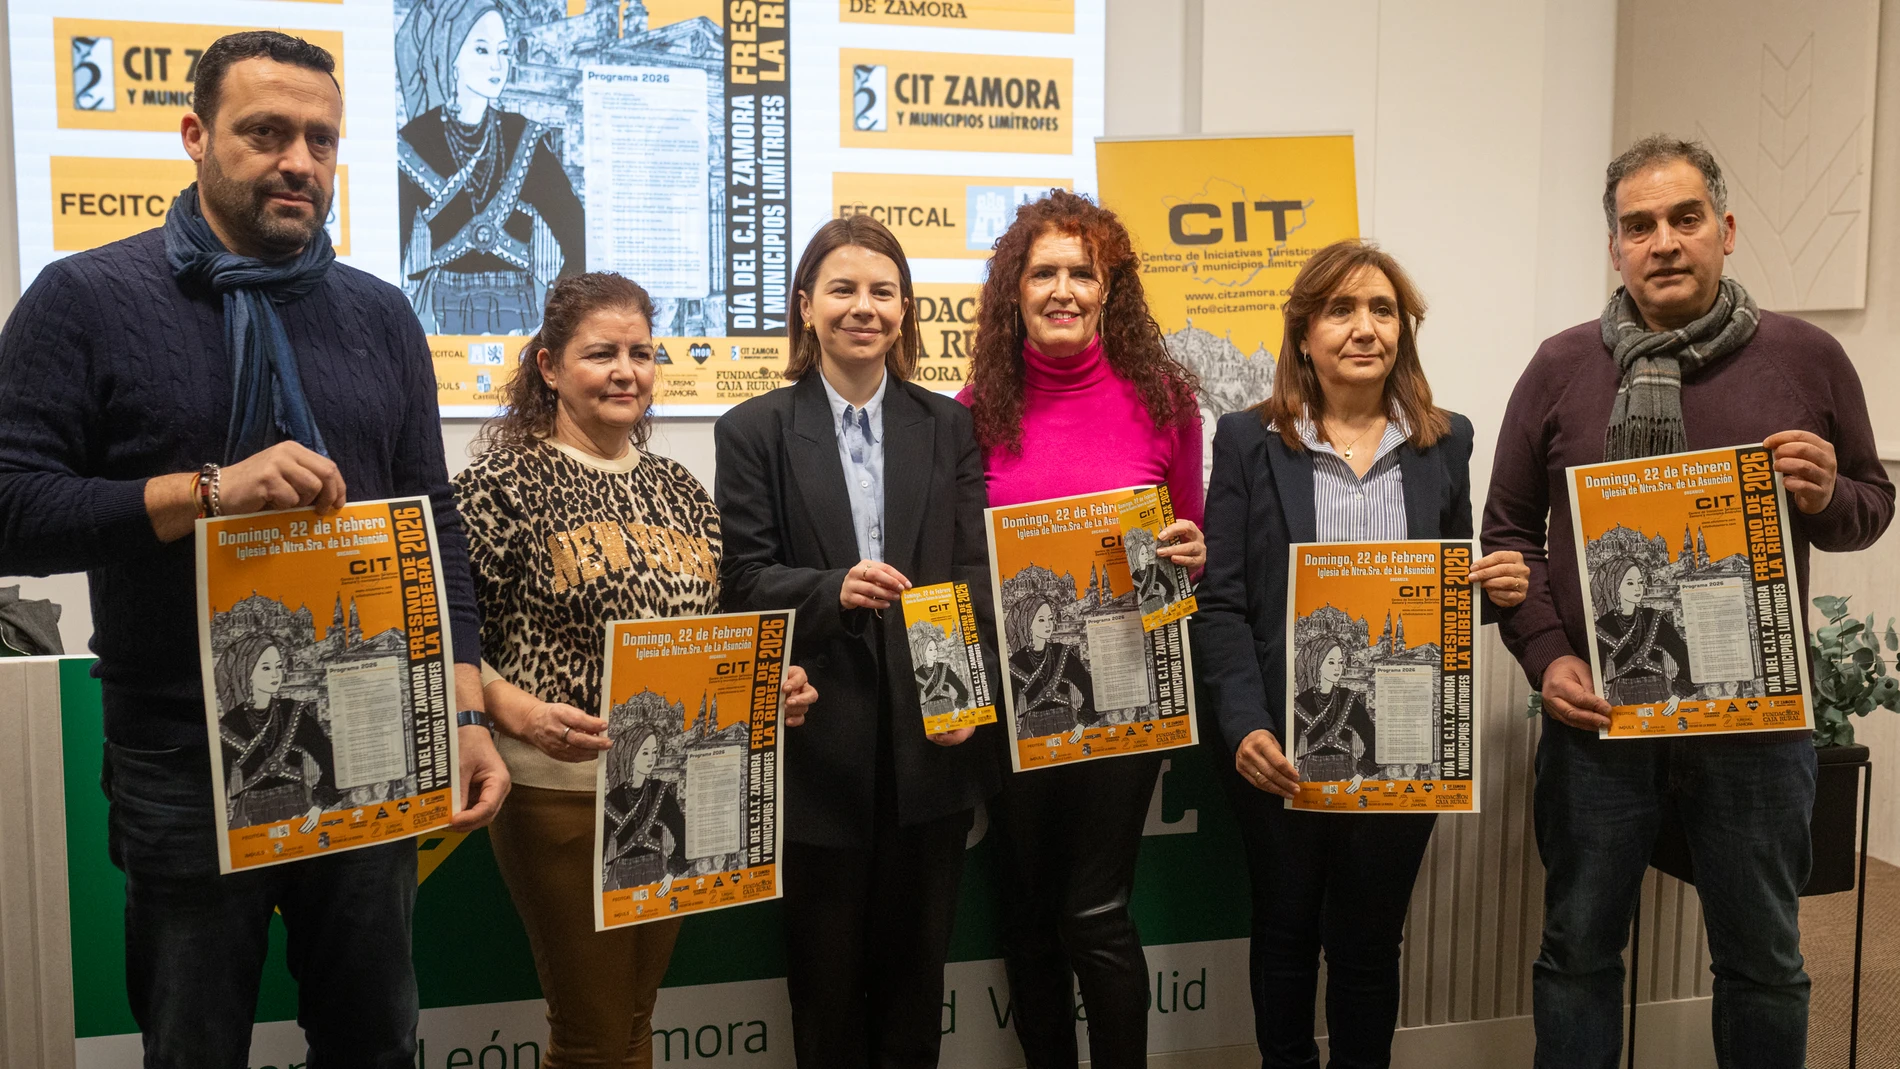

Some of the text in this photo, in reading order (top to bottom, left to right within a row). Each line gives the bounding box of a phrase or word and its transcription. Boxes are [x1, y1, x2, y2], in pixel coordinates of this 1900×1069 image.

[849, 0, 968, 19] DE ZAMORA
[730, 0, 757, 85] FRES
[759, 40, 785, 82] LA
[123, 47, 172, 82] CIT
[588, 71, 670, 83] Programa 2026
[894, 73, 1061, 110] CIT ZAMORA
[897, 111, 1059, 131] Y MUNICIPIOS LIMÍTROFES
[61, 193, 178, 217] FECITC
[728, 95, 757, 330] DÍA DEL C.I.T. ZAMORA
[757, 95, 786, 331] Y MUNICIPIOS LIMÍTROFES
[1169, 201, 1303, 246] CIT
[1142, 252, 1182, 263] Centro
[1186, 251, 1200, 261] de
[1204, 249, 1263, 260] Iniciativas
[1143, 264, 1188, 274] Zamora
[1192, 265, 1198, 275] y
[1203, 261, 1264, 272] municipios
[741, 347, 779, 355] CIT ZAMORA
[717, 381, 745, 391] CAJA
[1585, 461, 1732, 489] Domingo, 22 de Febrero
[1602, 487, 1627, 500] Iglesia
[1628, 484, 1638, 495] de
[1677, 479, 1686, 490] de
[1688, 478, 1697, 488] La
[1698, 474, 1733, 486] Asunción
[1740, 451, 1773, 492] 2026
[1002, 514, 1053, 529] Domingo,
[1056, 508, 1070, 521] 22
[1074, 506, 1087, 519] de
[1090, 502, 1117, 516] Febr
[1140, 508, 1157, 519] CIT
[1696, 495, 1735, 510] CIT
[218, 517, 387, 546] Domingo, 22 de Febrero
[394, 507, 427, 554] 2026
[1017, 528, 1040, 540] Iglesia
[1042, 526, 1050, 535] de
[1085, 520, 1093, 529] de
[1094, 518, 1102, 528] La
[1101, 535, 1122, 549] CI
[1745, 494, 1770, 582] FRESNO DE
[1761, 494, 1785, 579] LA RIBERA
[350, 557, 392, 575] CIT
[547, 521, 717, 593] NEW YORK
[1305, 551, 1436, 567] Domingo, 22 de Febrero
[1318, 567, 1340, 579] Iglesia
[1342, 567, 1350, 576] de
[1384, 566, 1393, 575] de
[1394, 566, 1402, 575] La
[1404, 565, 1435, 575] Asunción
[1444, 548, 1470, 585] 2026
[402, 557, 426, 660] FRESNO DE
[417, 557, 441, 656] LA RIBERA
[929, 603, 950, 613] CIT
[1399, 586, 1435, 598] CIT
[1773, 584, 1791, 632] LIMÍTROFES
[623, 626, 753, 647] Domingo, 22 de Febrero
[636, 648, 660, 661] Iglesia
[662, 647, 671, 657] de
[704, 643, 713, 653] de
[714, 642, 722, 652] La
[723, 639, 752, 651] Asunción
[759, 619, 785, 659] 2026
[1444, 588, 1457, 671] FRESNO DE
[1458, 589, 1471, 670] LA RIBERA
[1757, 585, 1782, 693] DÍA DEL C.I.T. ZAMORA
[717, 661, 750, 676] CIT
[1154, 627, 1173, 716] DÍA DEL C.I.T. ZAMO
[1779, 634, 1798, 685] MUNICIPIOS
[763, 662, 781, 746] LA RIBERA
[1171, 661, 1185, 707] MUNICIPIOS
[1456, 675, 1470, 721] LIMÍTROFES
[751, 662, 770, 750] FRESNO DE
[1442, 675, 1456, 777] DÍA DEL C.I.T. ZAMORA
[412, 664, 433, 790] DÍA DEL C.I.T. ZAMORA
[1458, 722, 1470, 770] MUNICIPIOS
[433, 719, 448, 778] MUNICIPIOS
[762, 752, 774, 801] LIMÍTROFES
[748, 753, 761, 864] DÍA DEL C.I.T. ZAMORA
[763, 802, 774, 854] MUNICIPIOS
[651, 1020, 769, 1063] mora
